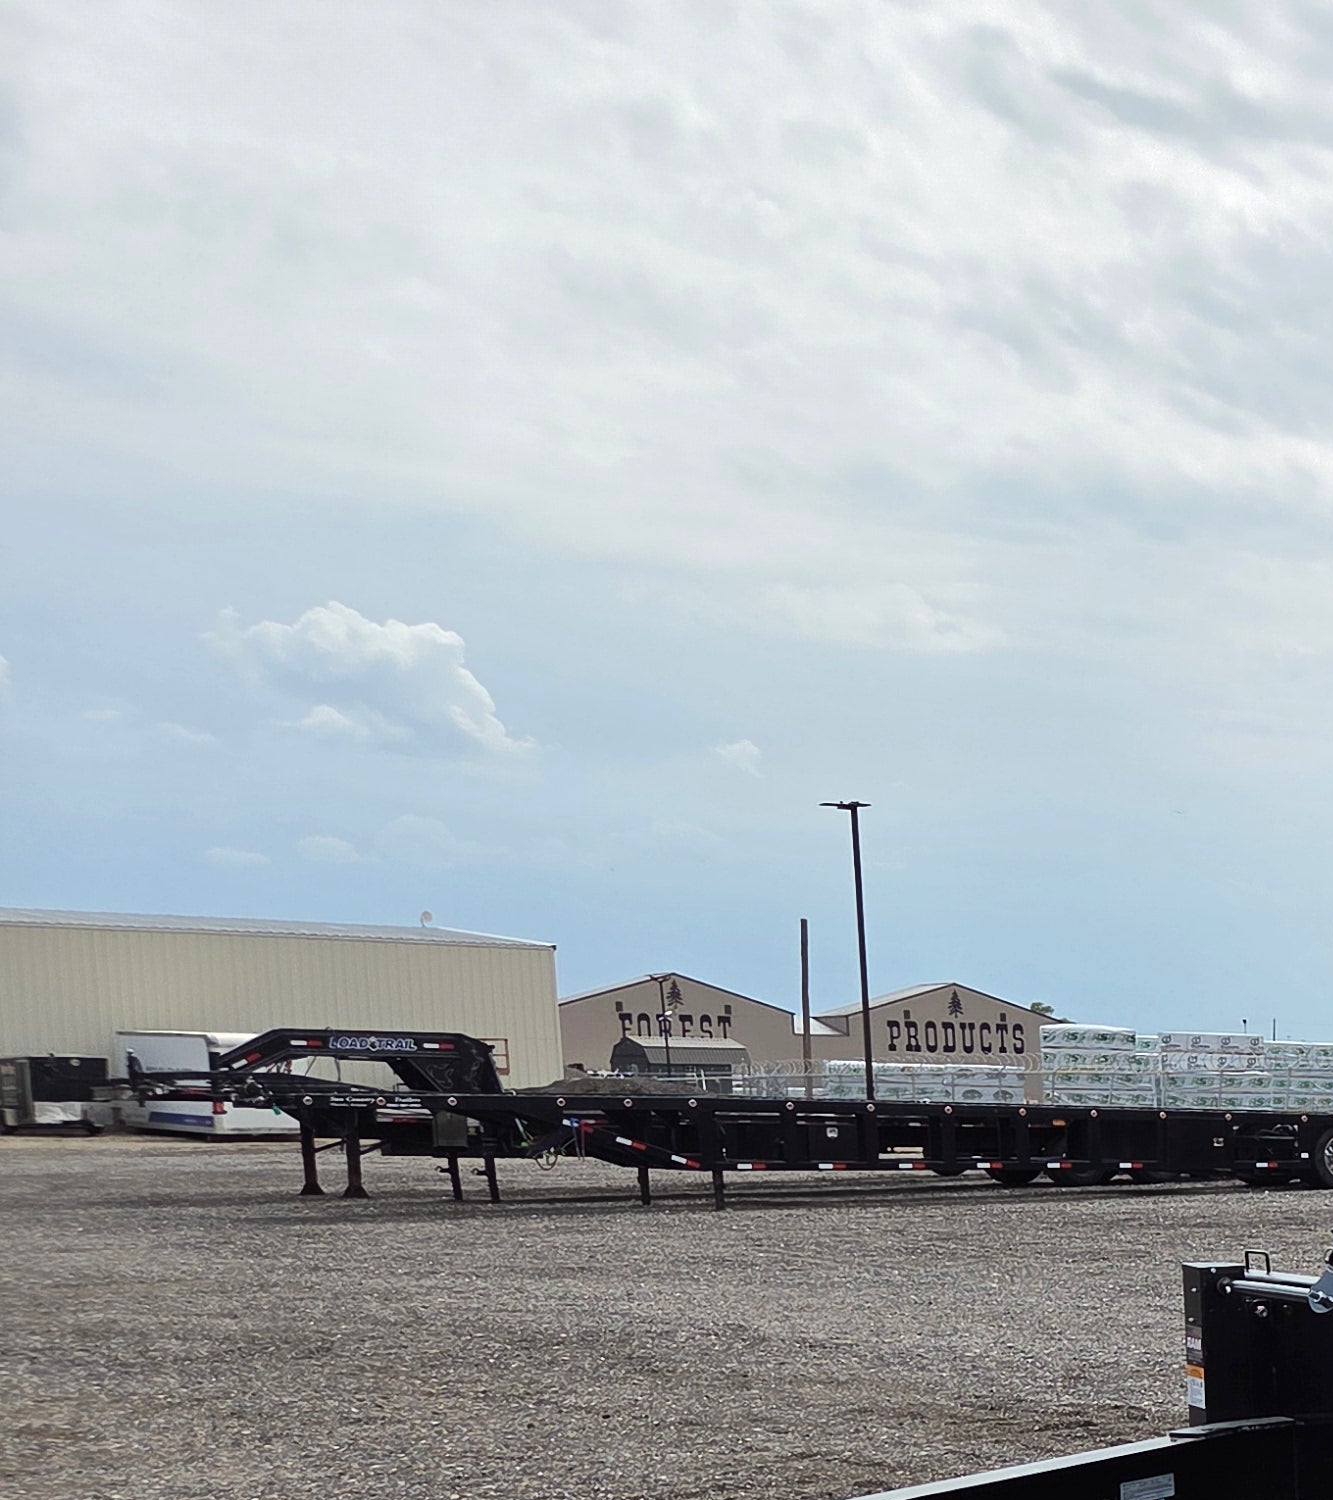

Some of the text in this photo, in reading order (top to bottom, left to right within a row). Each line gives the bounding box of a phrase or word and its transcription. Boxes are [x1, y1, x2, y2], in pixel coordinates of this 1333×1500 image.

[618, 1012, 732, 1039] FOREST
[886, 1020, 1025, 1055] PRODUCTS
[329, 1037, 417, 1051] LOAD TRAIL
